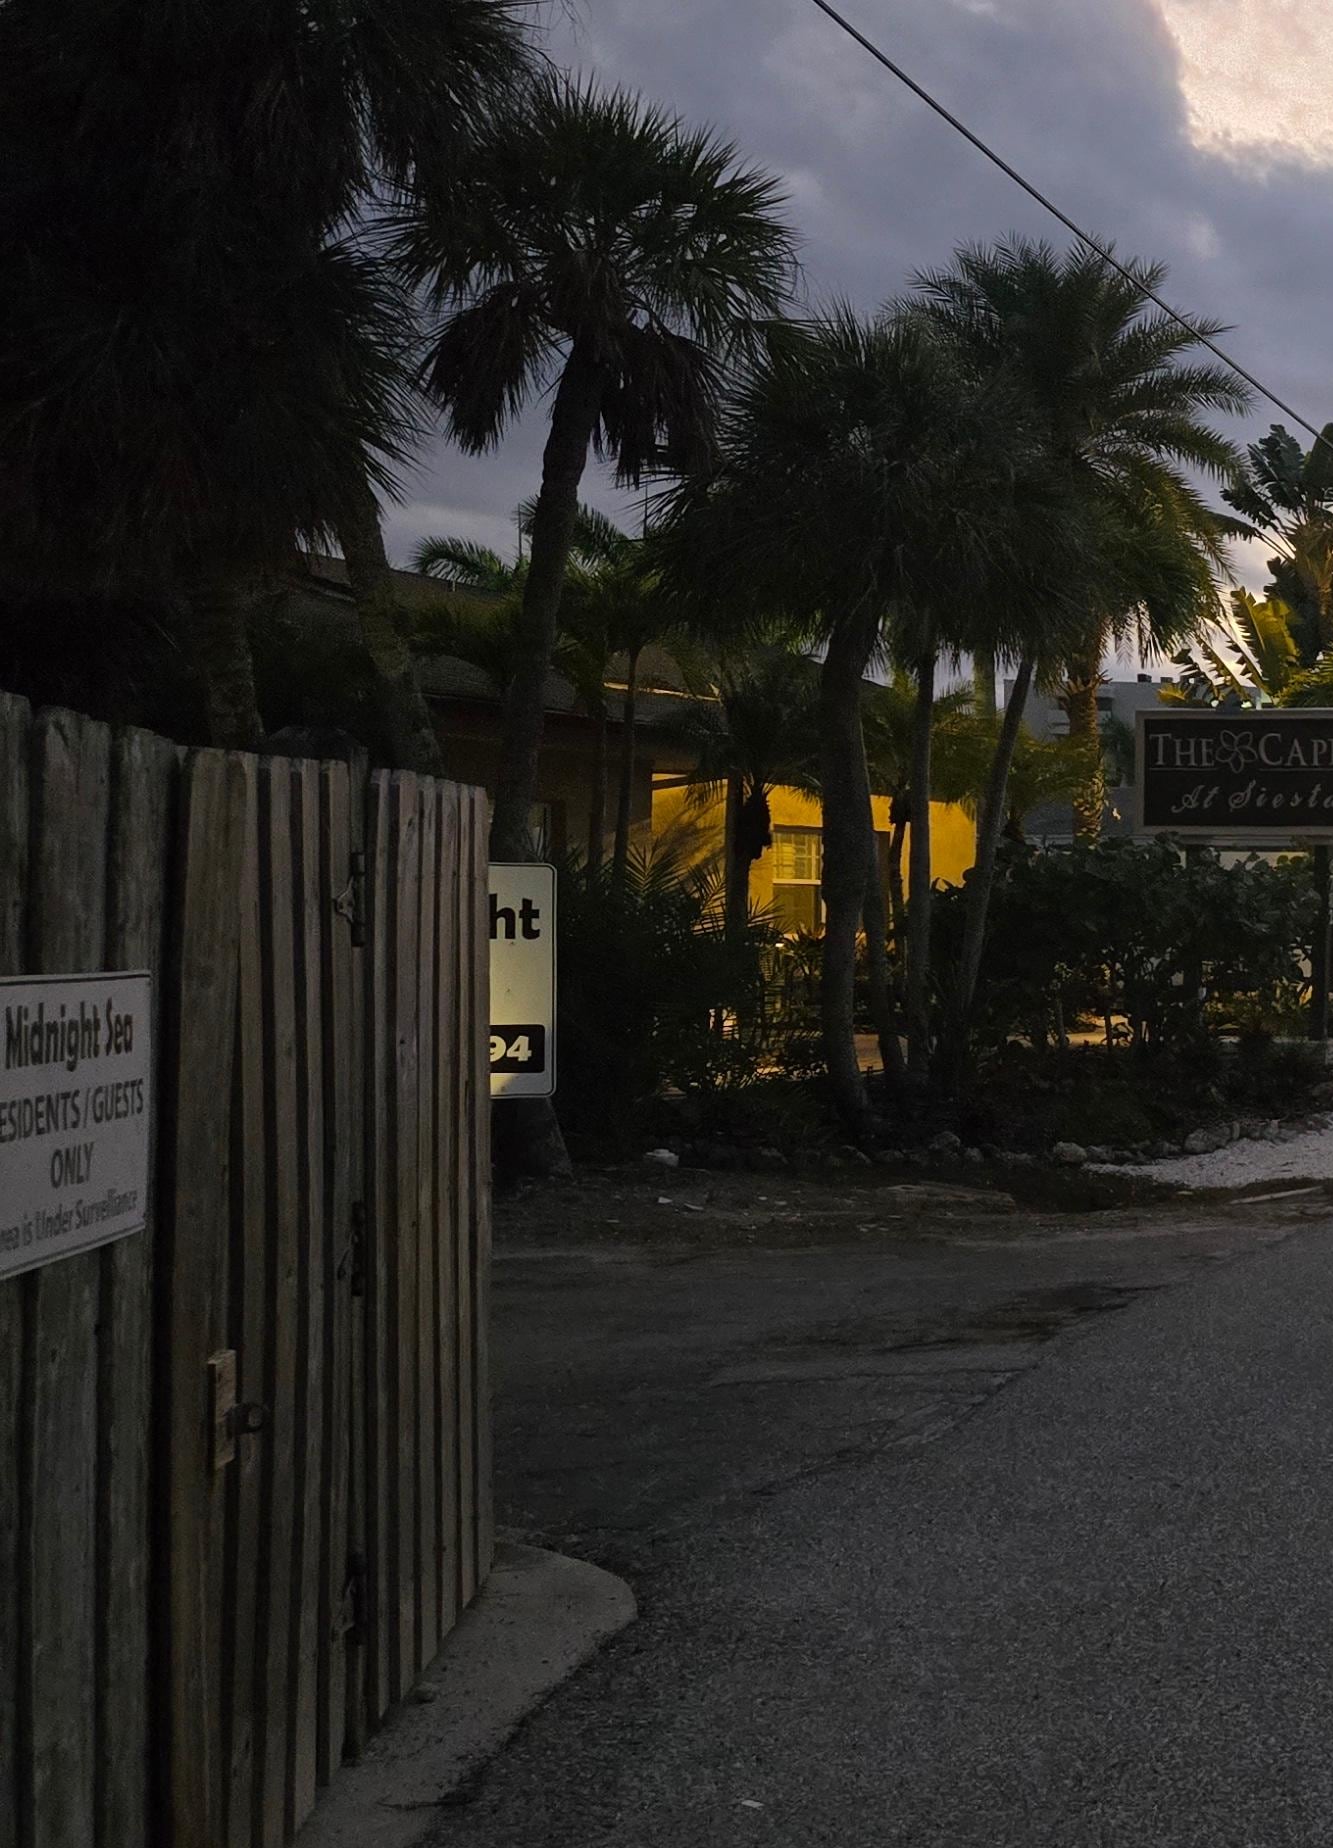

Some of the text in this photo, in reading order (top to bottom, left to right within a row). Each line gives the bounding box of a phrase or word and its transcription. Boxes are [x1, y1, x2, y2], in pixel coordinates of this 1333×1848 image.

[1149, 733, 1216, 767] THE
[1171, 784, 1220, 814] At
[489, 893, 540, 940] ht
[5, 997, 134, 1072] Midnight Sea
[489, 1034, 533, 1063] 94
[92, 1078, 144, 1123] GUESTS
[51, 1141, 95, 1189] ONLY
[35, 1202, 73, 1240] Under
